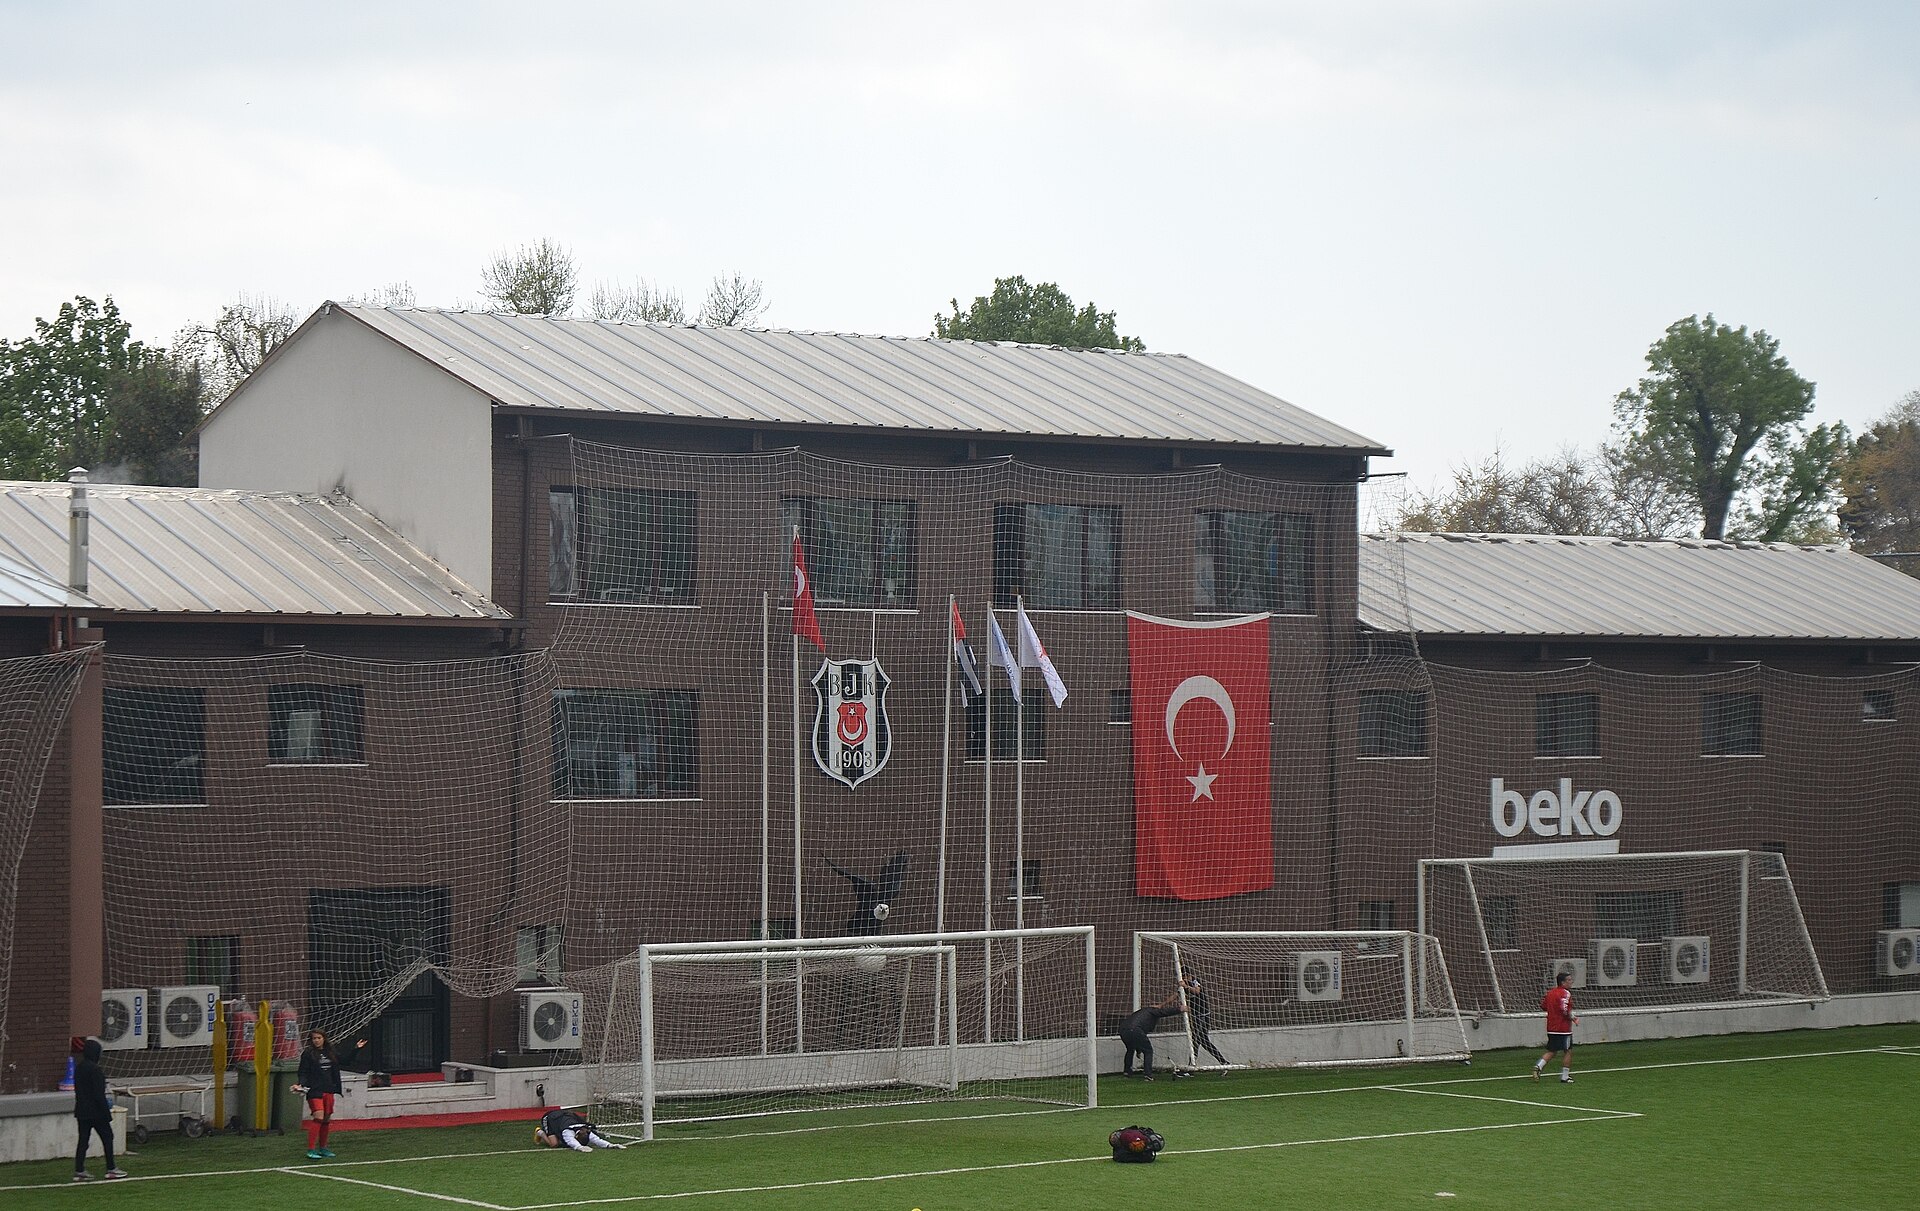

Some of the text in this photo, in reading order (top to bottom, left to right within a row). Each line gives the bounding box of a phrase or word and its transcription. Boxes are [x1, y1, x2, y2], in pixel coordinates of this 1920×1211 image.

[834, 750, 873, 768] 1903
[1492, 777, 1623, 838] beko
[134, 996, 142, 1036] BEKO
